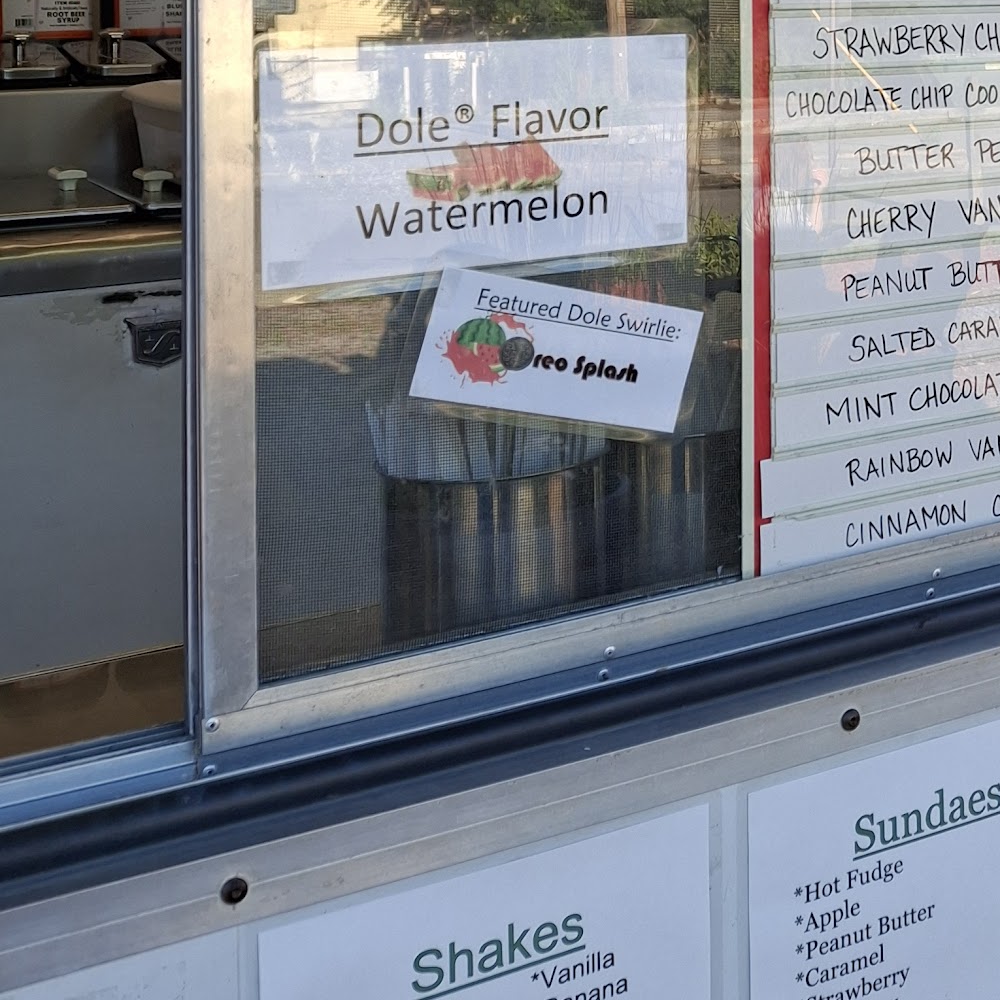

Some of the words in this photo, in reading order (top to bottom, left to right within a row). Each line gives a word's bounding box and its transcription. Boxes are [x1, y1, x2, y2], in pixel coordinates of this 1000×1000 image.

[491, 103, 609, 139] Flavor
[355, 185, 609, 240] Watermelon
[846, 201, 937, 240] CHERRY
[476, 288, 561, 320] Featured
[567, 303, 611, 328] Dole
[616, 312, 681, 341] Swirlie:
[573, 355, 639, 384] Splash
[825, 391, 897, 426] MINT
[845, 500, 967, 549] CINNAMON
[846, 858, 904, 892] Fudge
[877, 903, 936, 937] Butter
[410, 912, 585, 994] Shakes
